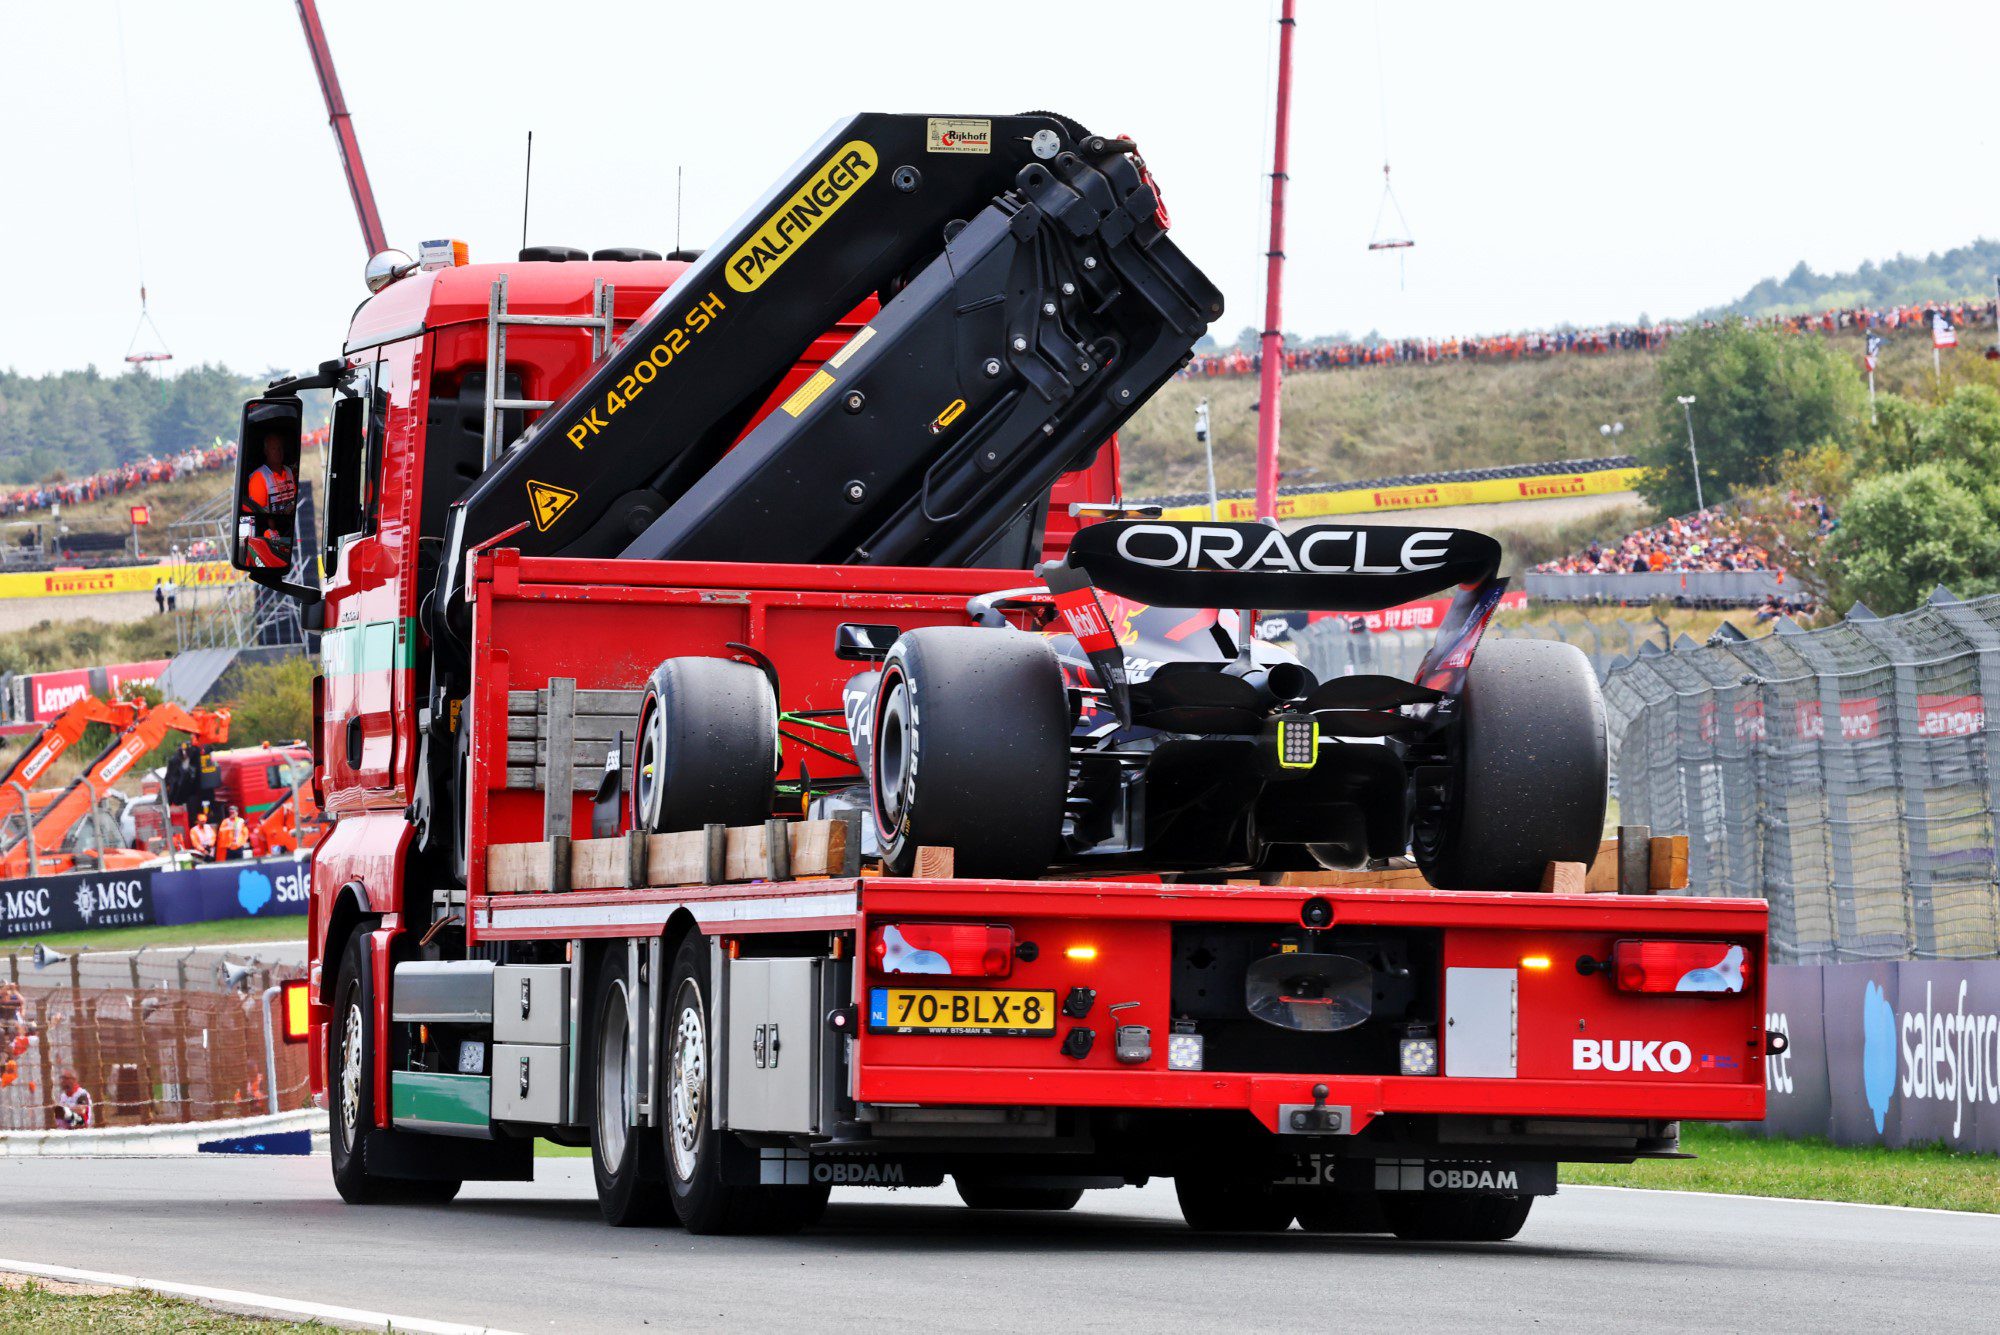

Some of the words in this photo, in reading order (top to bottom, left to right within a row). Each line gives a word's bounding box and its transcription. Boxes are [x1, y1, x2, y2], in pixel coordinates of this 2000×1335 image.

[949, 130, 988, 142] Rijkhoff
[733, 150, 871, 286] PALFINGER
[566, 407, 610, 450] PK
[1518, 477, 1586, 496] PIRELLI
[1116, 524, 1454, 573] ORACLE
[1063, 604, 1101, 638] Mobil
[907, 704, 920, 805] ZERO
[5, 888, 50, 919] MSC
[96, 880, 143, 911] MSC
[8, 920, 52, 933] CRUISES
[99, 912, 144, 924] CRUISES
[872, 1012, 885, 1020] NL
[898, 994, 1042, 1025] 70-BLX-8
[1573, 1039, 1692, 1074] BUKO
[1902, 979, 2000, 1139] salesforc
[813, 1163, 905, 1183] OBDAM
[1428, 1170, 1519, 1190] OBDAM
